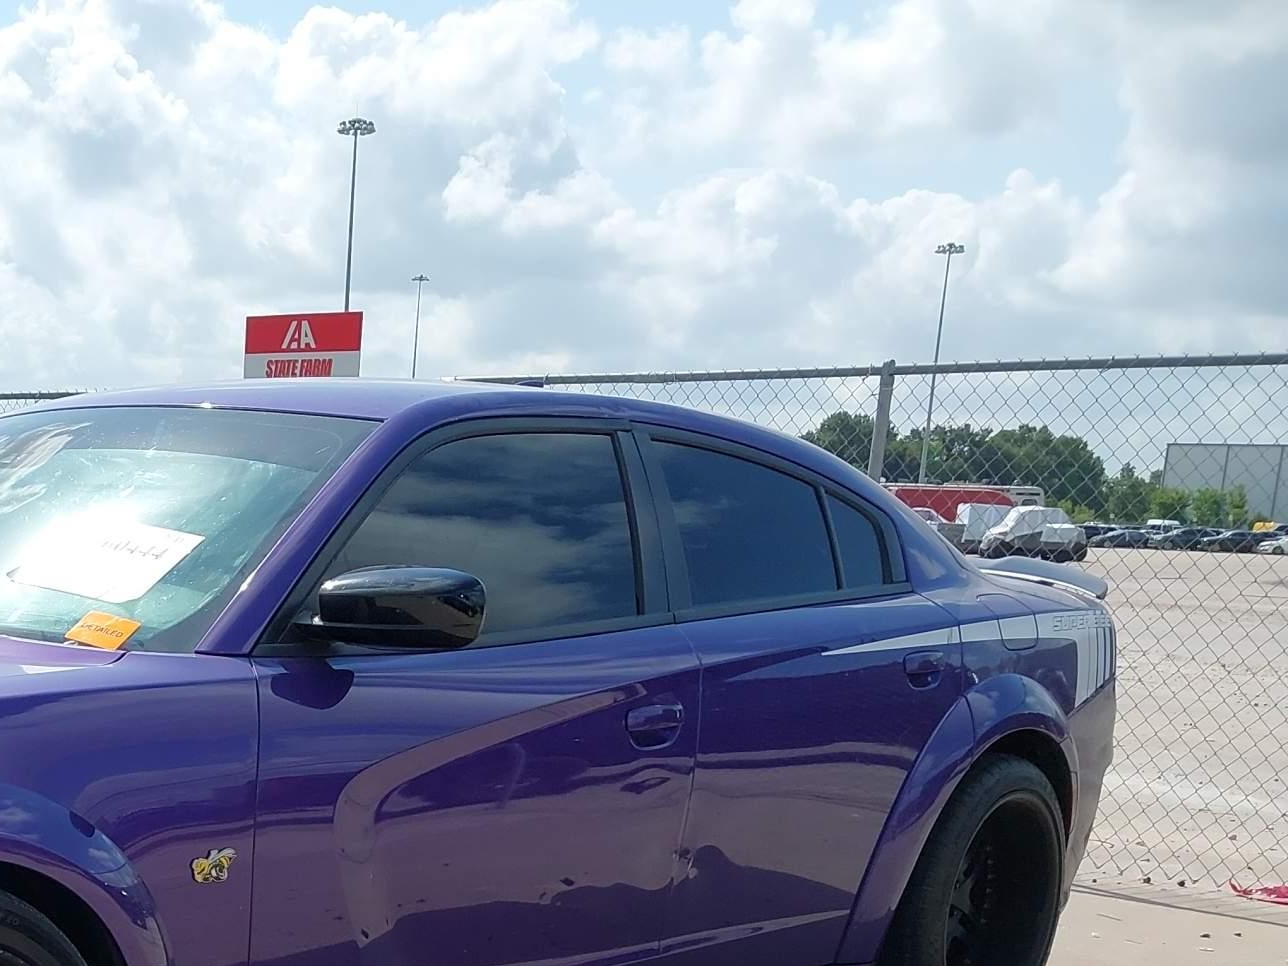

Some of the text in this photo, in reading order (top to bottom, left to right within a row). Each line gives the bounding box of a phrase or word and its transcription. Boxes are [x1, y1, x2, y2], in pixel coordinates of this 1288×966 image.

[265, 358, 333, 378] STATE FARM
[80, 623, 123, 638] DETAILED
